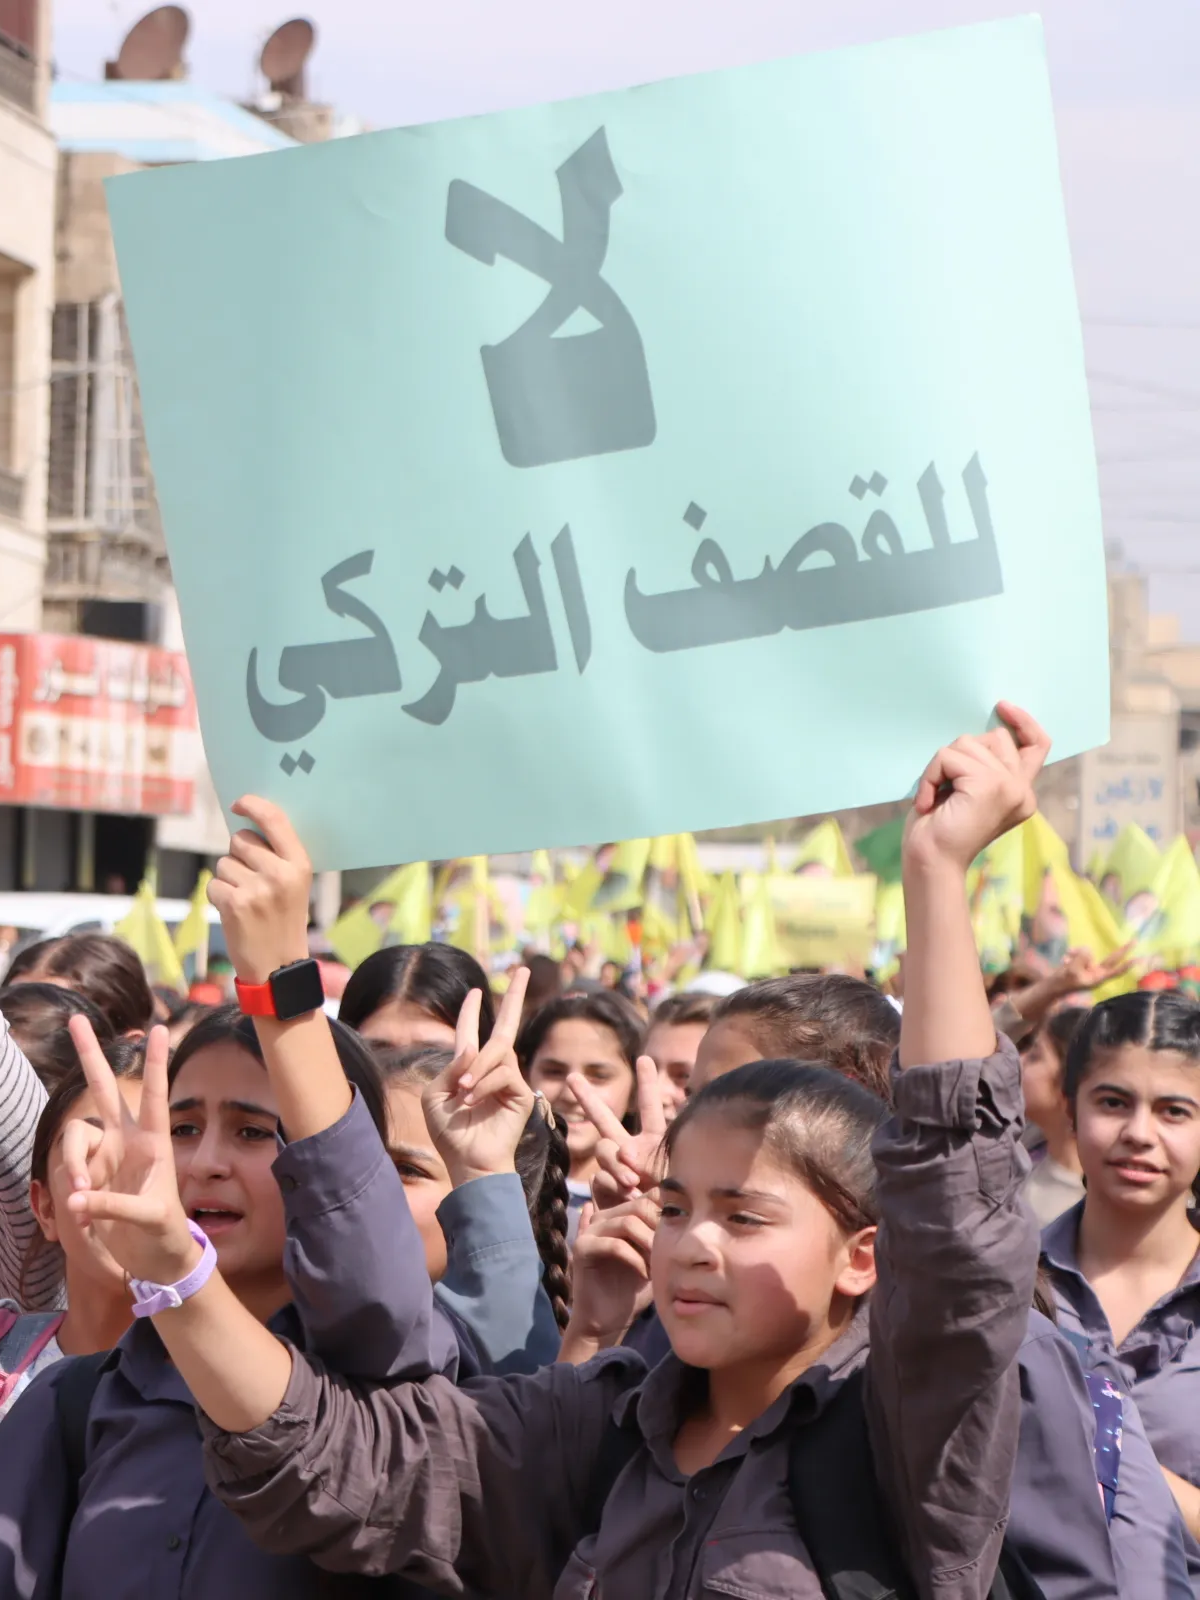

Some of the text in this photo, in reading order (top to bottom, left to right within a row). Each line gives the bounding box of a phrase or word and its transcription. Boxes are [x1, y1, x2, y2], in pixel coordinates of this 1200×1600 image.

[443, 124, 658, 469] لا
[245, 450, 1005, 777] للقصف التركي
